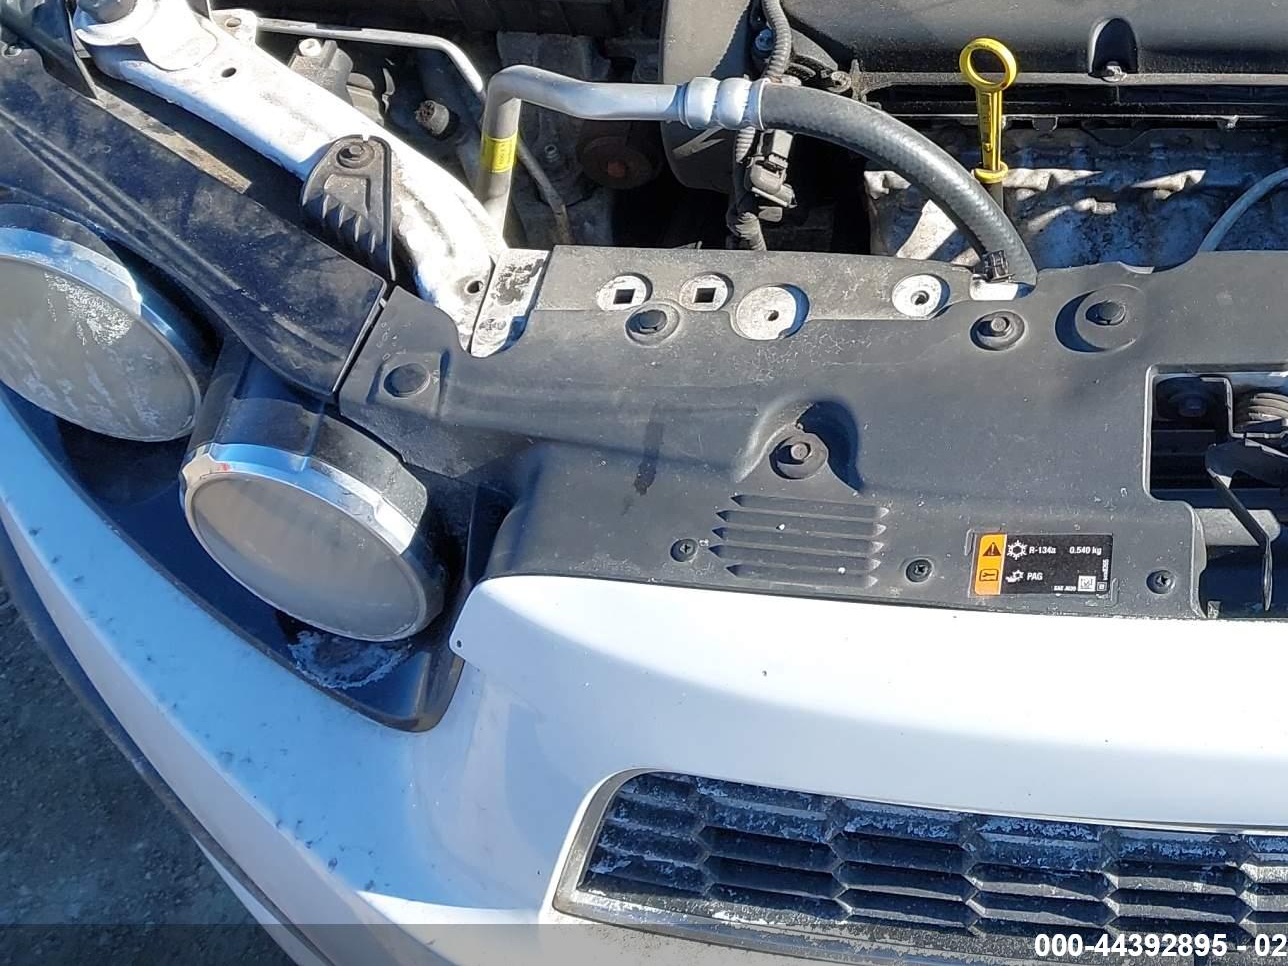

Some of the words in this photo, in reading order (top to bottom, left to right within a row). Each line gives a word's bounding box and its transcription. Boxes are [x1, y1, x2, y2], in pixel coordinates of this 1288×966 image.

[1028, 546, 1057, 554] R-134a
[1069, 546, 1091, 554] 0.540
[1091, 546, 1102, 556] kg
[1026, 572, 1044, 581] PAG
